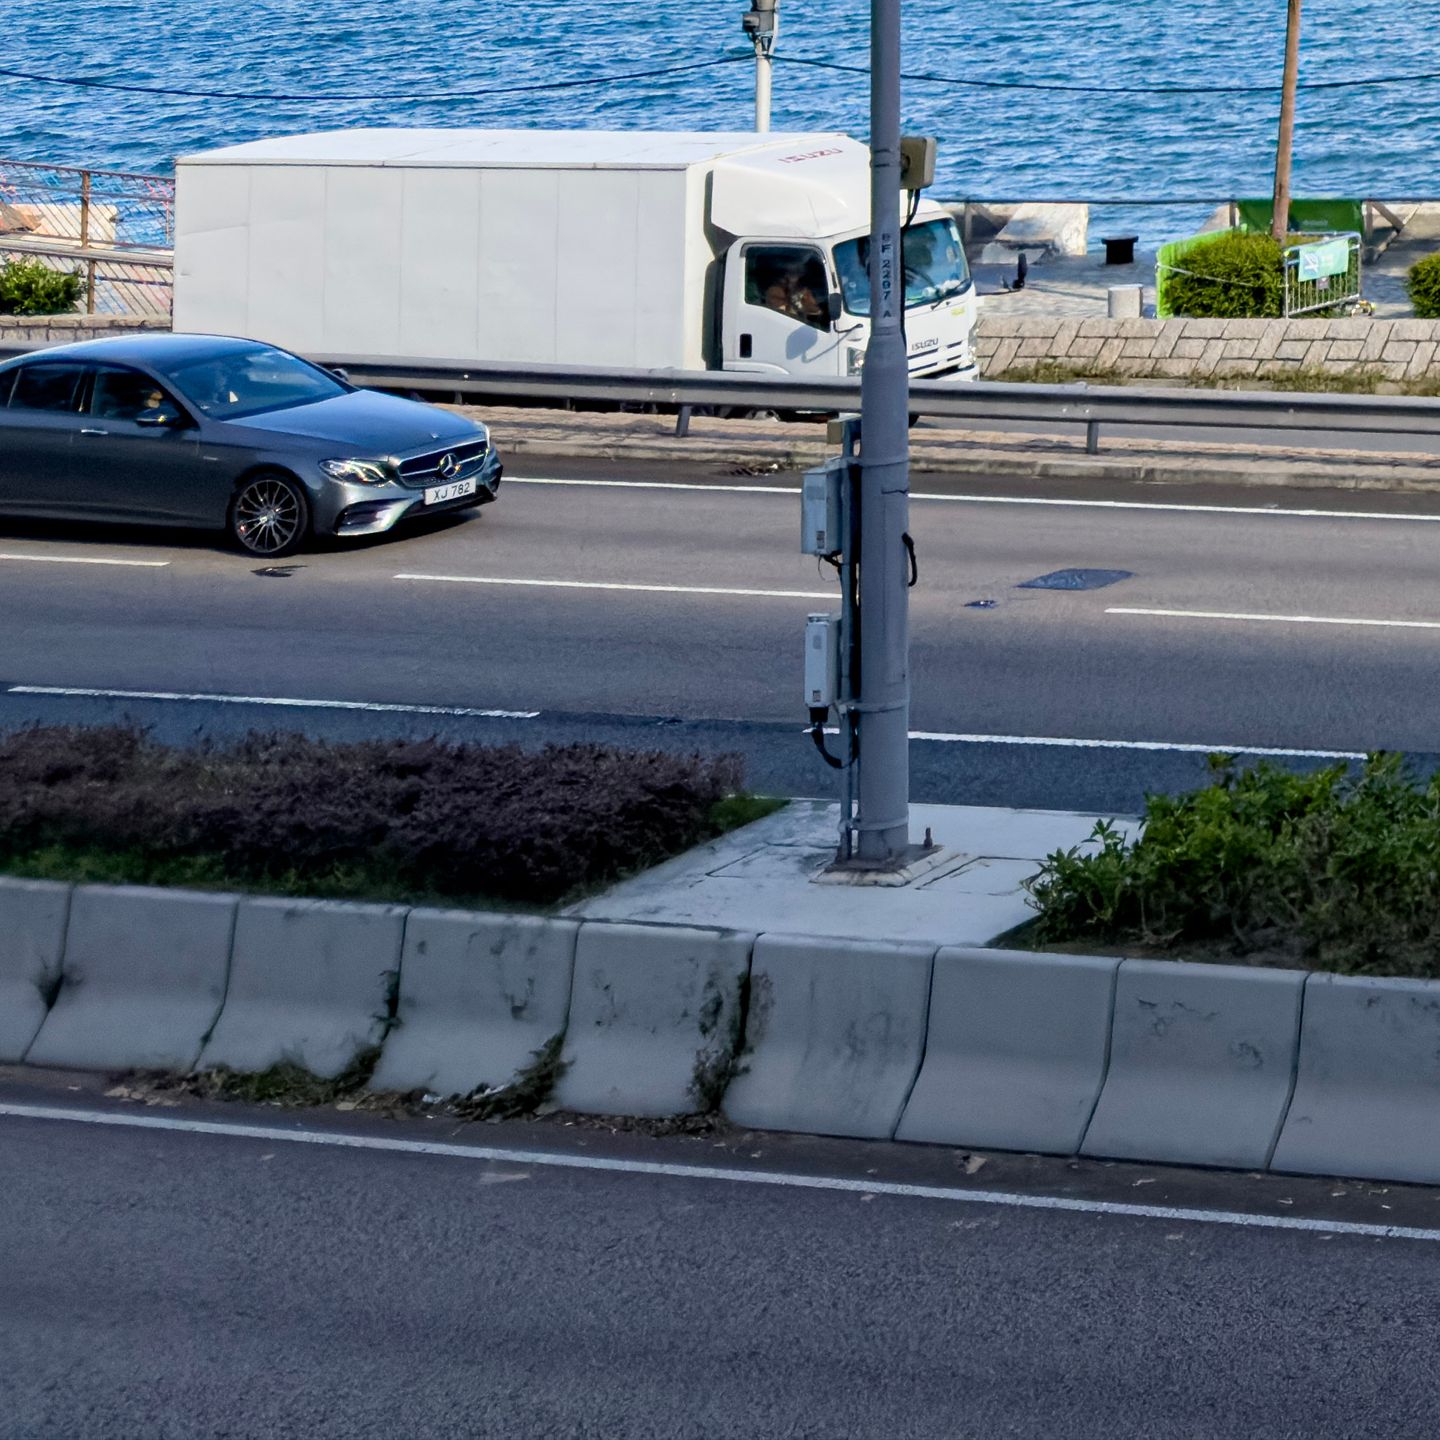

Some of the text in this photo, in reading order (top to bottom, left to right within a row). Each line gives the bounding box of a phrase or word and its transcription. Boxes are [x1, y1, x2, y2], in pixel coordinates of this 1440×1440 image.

[911, 337, 939, 351] ISUZU
[433, 482, 470, 501] XJ 782
